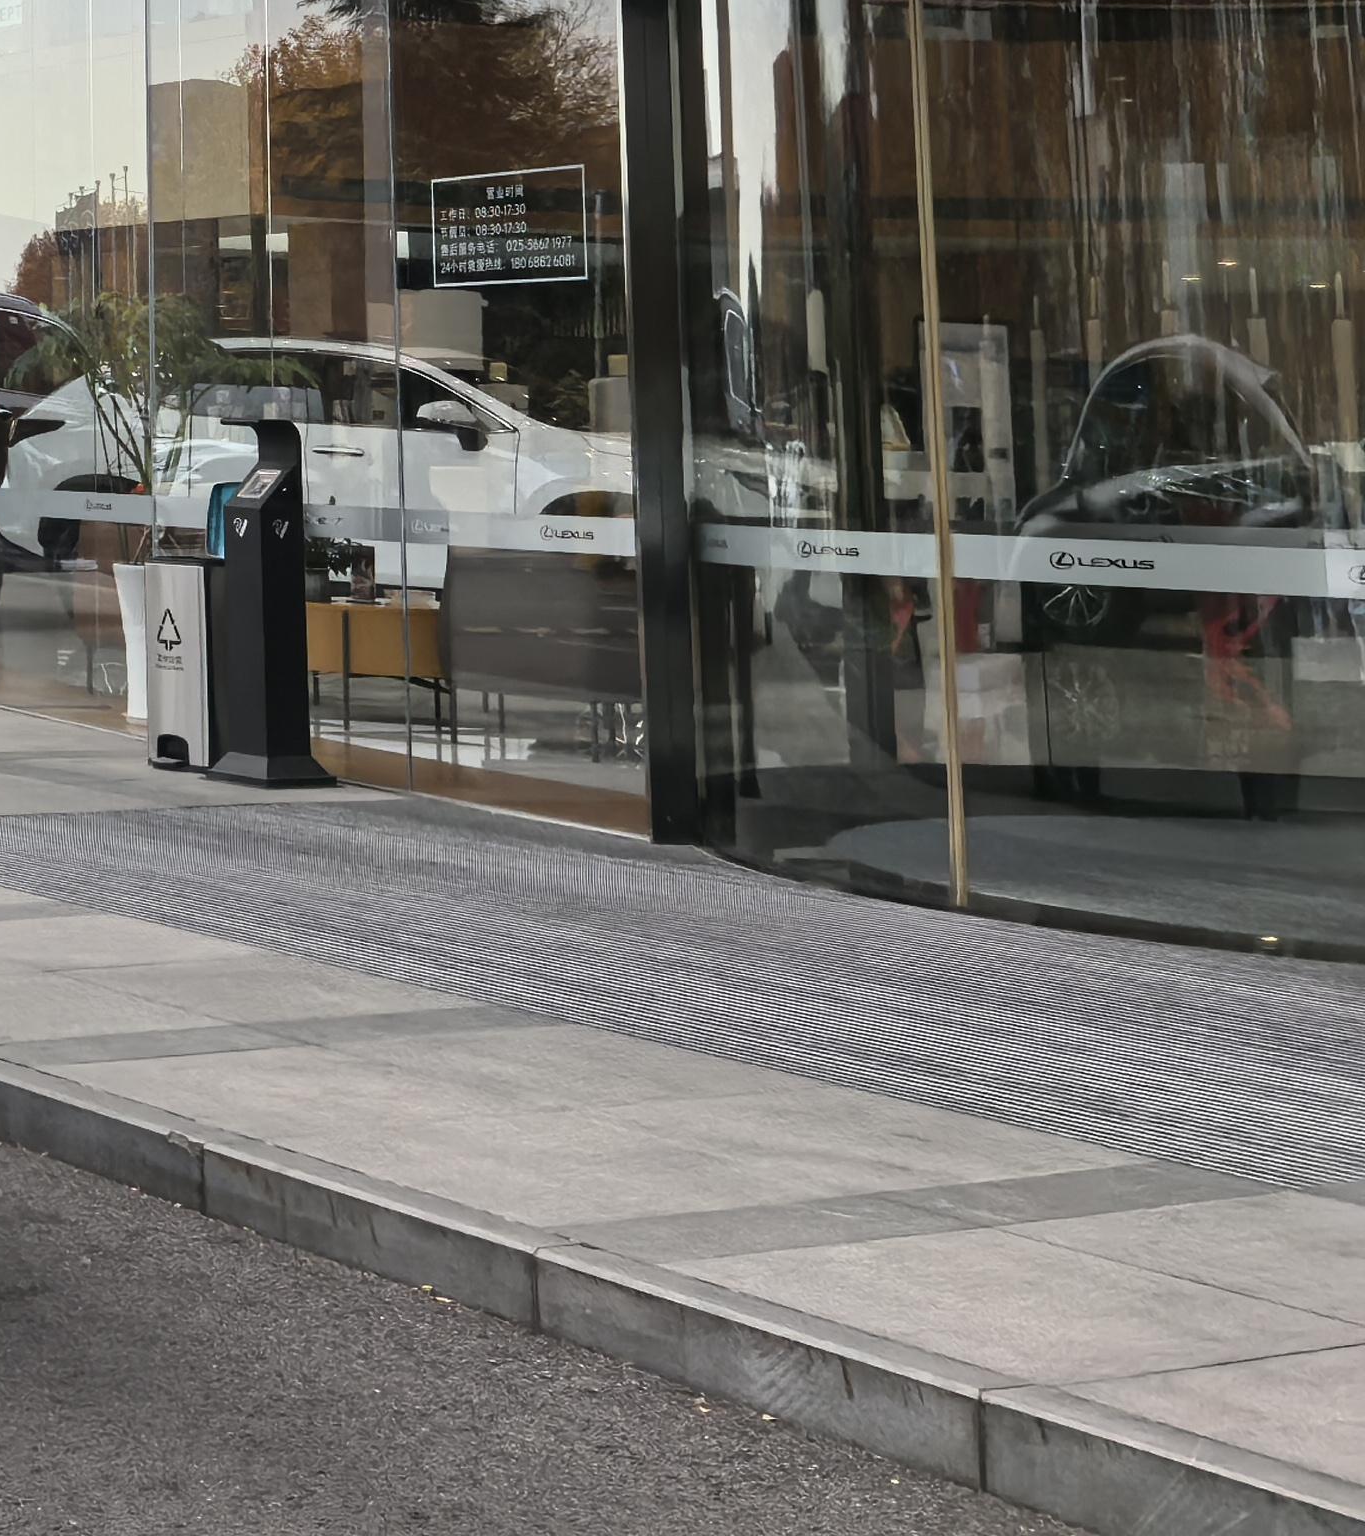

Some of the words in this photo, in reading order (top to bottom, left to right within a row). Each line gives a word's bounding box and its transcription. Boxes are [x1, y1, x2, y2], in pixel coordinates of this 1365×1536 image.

[555, 530, 594, 540] LEXUS
[812, 545, 860, 558] LEXUS
[1077, 556, 1156, 571] LEXUS
